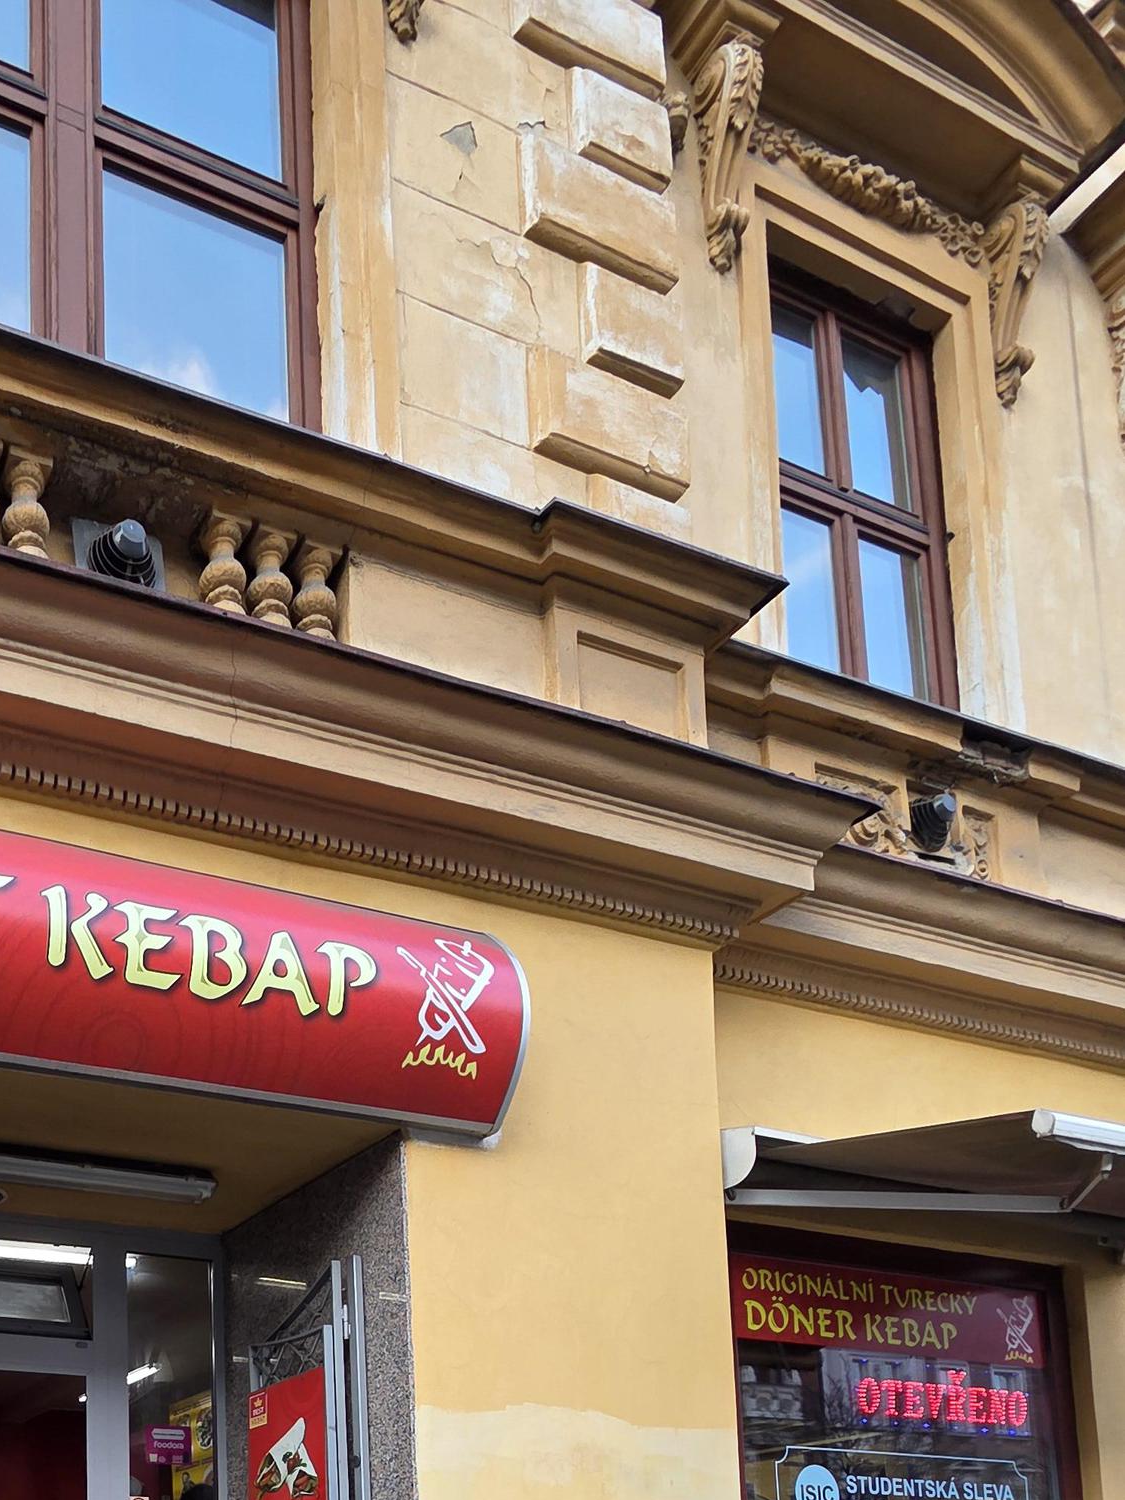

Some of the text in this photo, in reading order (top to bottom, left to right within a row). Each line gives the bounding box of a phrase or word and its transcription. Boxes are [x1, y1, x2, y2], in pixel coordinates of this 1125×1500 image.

[41, 885, 378, 1017] KEBAP
[741, 1266, 978, 1315] ORIGINÁLNÍ TURECKÝ
[743, 1295, 959, 1350] DÖNER KEBAP
[856, 1368, 1028, 1427] OTEVŘENO
[153, 1440, 185, 1450] foodora
[846, 1473, 961, 1500] STUDENTSKÁ
